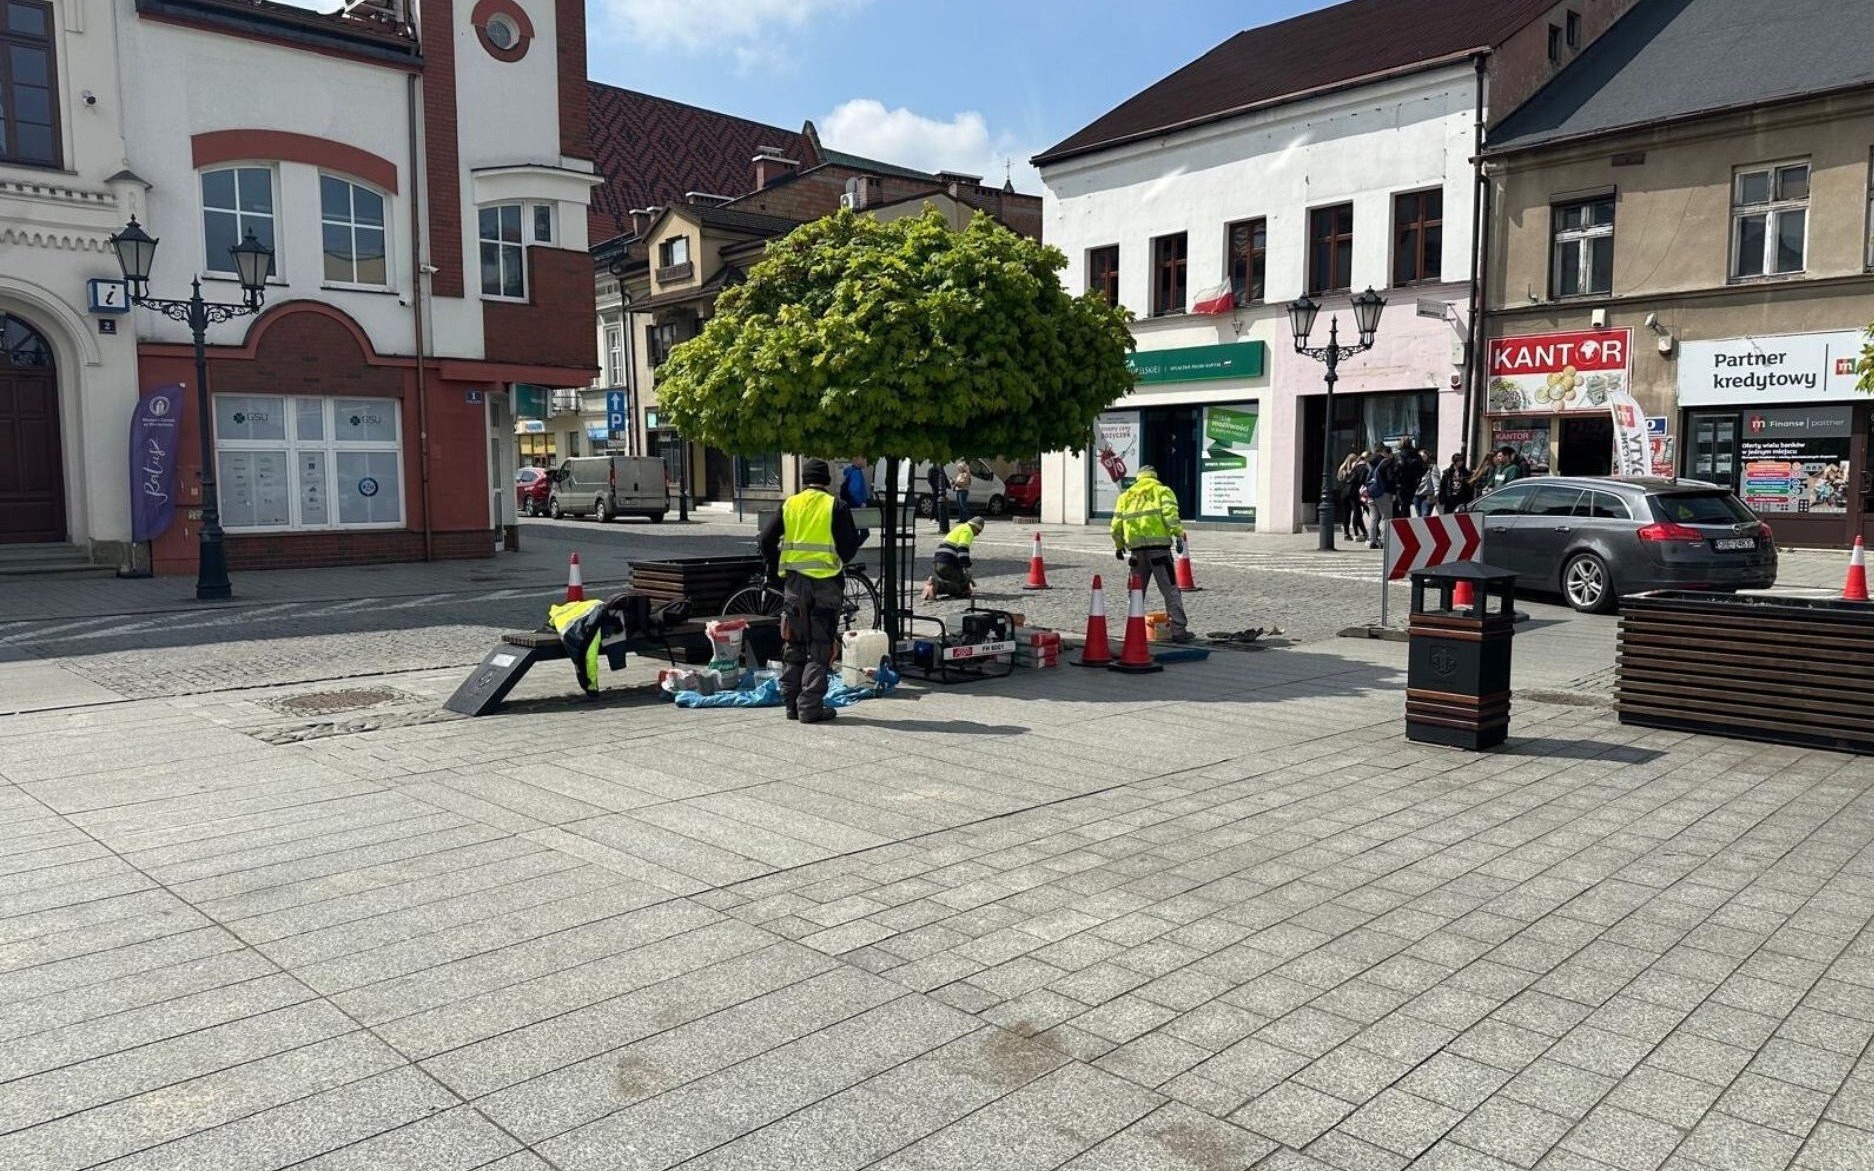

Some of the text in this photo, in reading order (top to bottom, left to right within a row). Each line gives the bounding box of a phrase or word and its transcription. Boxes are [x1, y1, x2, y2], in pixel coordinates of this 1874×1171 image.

[1494, 339, 1622, 369] KANTOR
[1714, 351, 1787, 368] Partner
[1713, 371, 1817, 391] kredytowy
[611, 413, 622, 429] P
[1770, 419, 1804, 428] Finanse
[1496, 432, 1529, 440] KANTOR
